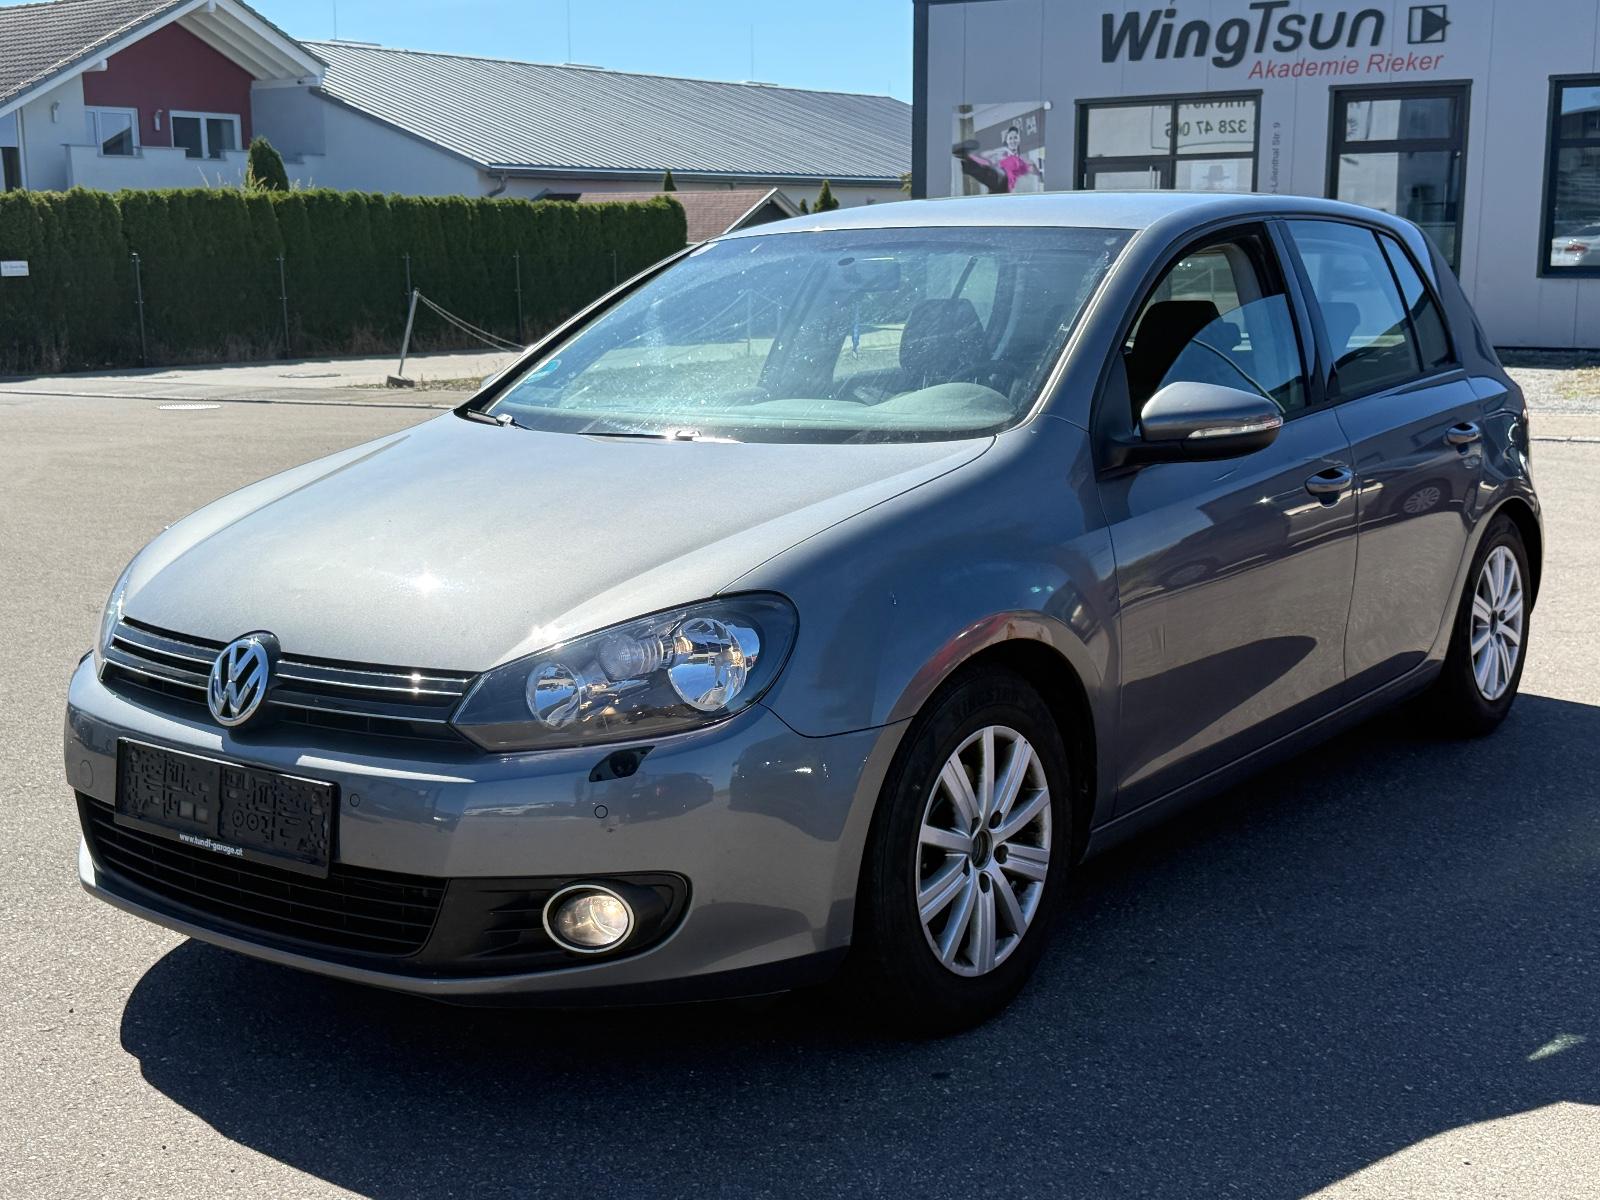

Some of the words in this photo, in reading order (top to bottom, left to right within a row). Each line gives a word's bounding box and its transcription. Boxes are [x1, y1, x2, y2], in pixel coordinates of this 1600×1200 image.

[1101, 0, 1385, 69] WingTsun
[1248, 55, 1360, 80] Akademie
[1366, 52, 1445, 74] Rieker
